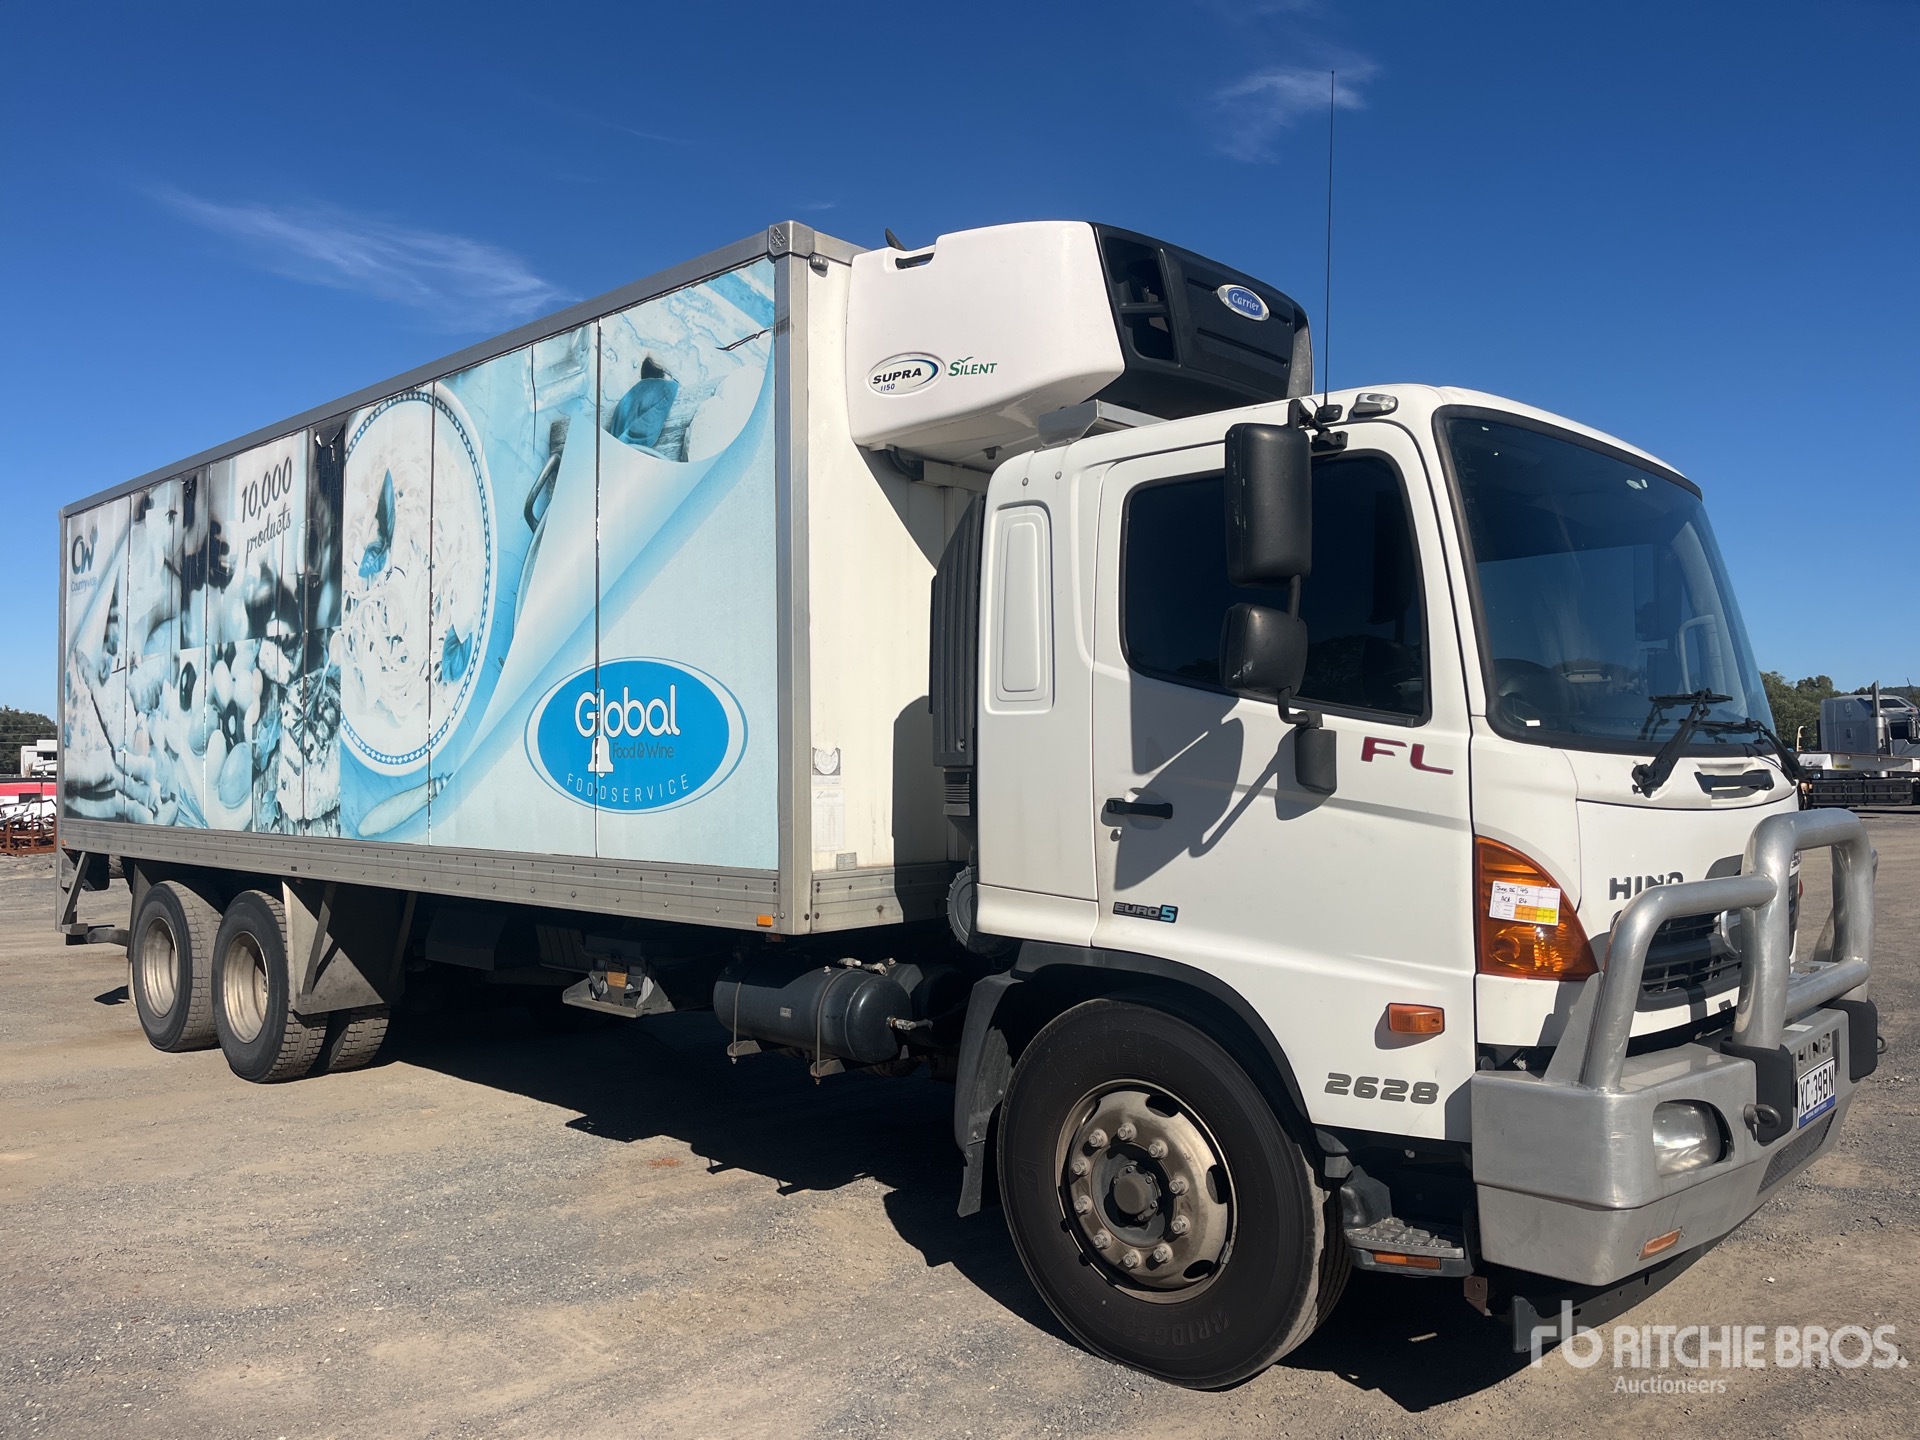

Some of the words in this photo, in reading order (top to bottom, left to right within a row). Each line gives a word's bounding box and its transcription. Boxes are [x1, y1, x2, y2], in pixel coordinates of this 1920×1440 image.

[1232, 292, 1260, 312] Carrier
[872, 367, 923, 385] SUPRA
[948, 359, 998, 377] SILENT
[880, 383, 896, 392] 1150
[241, 456, 293, 524] 10,000
[245, 502, 292, 568] products
[574, 683, 681, 738] Global
[612, 742, 636, 759] Food
[646, 742, 675, 759] Wine
[1361, 736, 1454, 775] FL
[566, 773, 690, 803] FOODSERVICE
[1324, 1072, 1440, 1105] 2628
